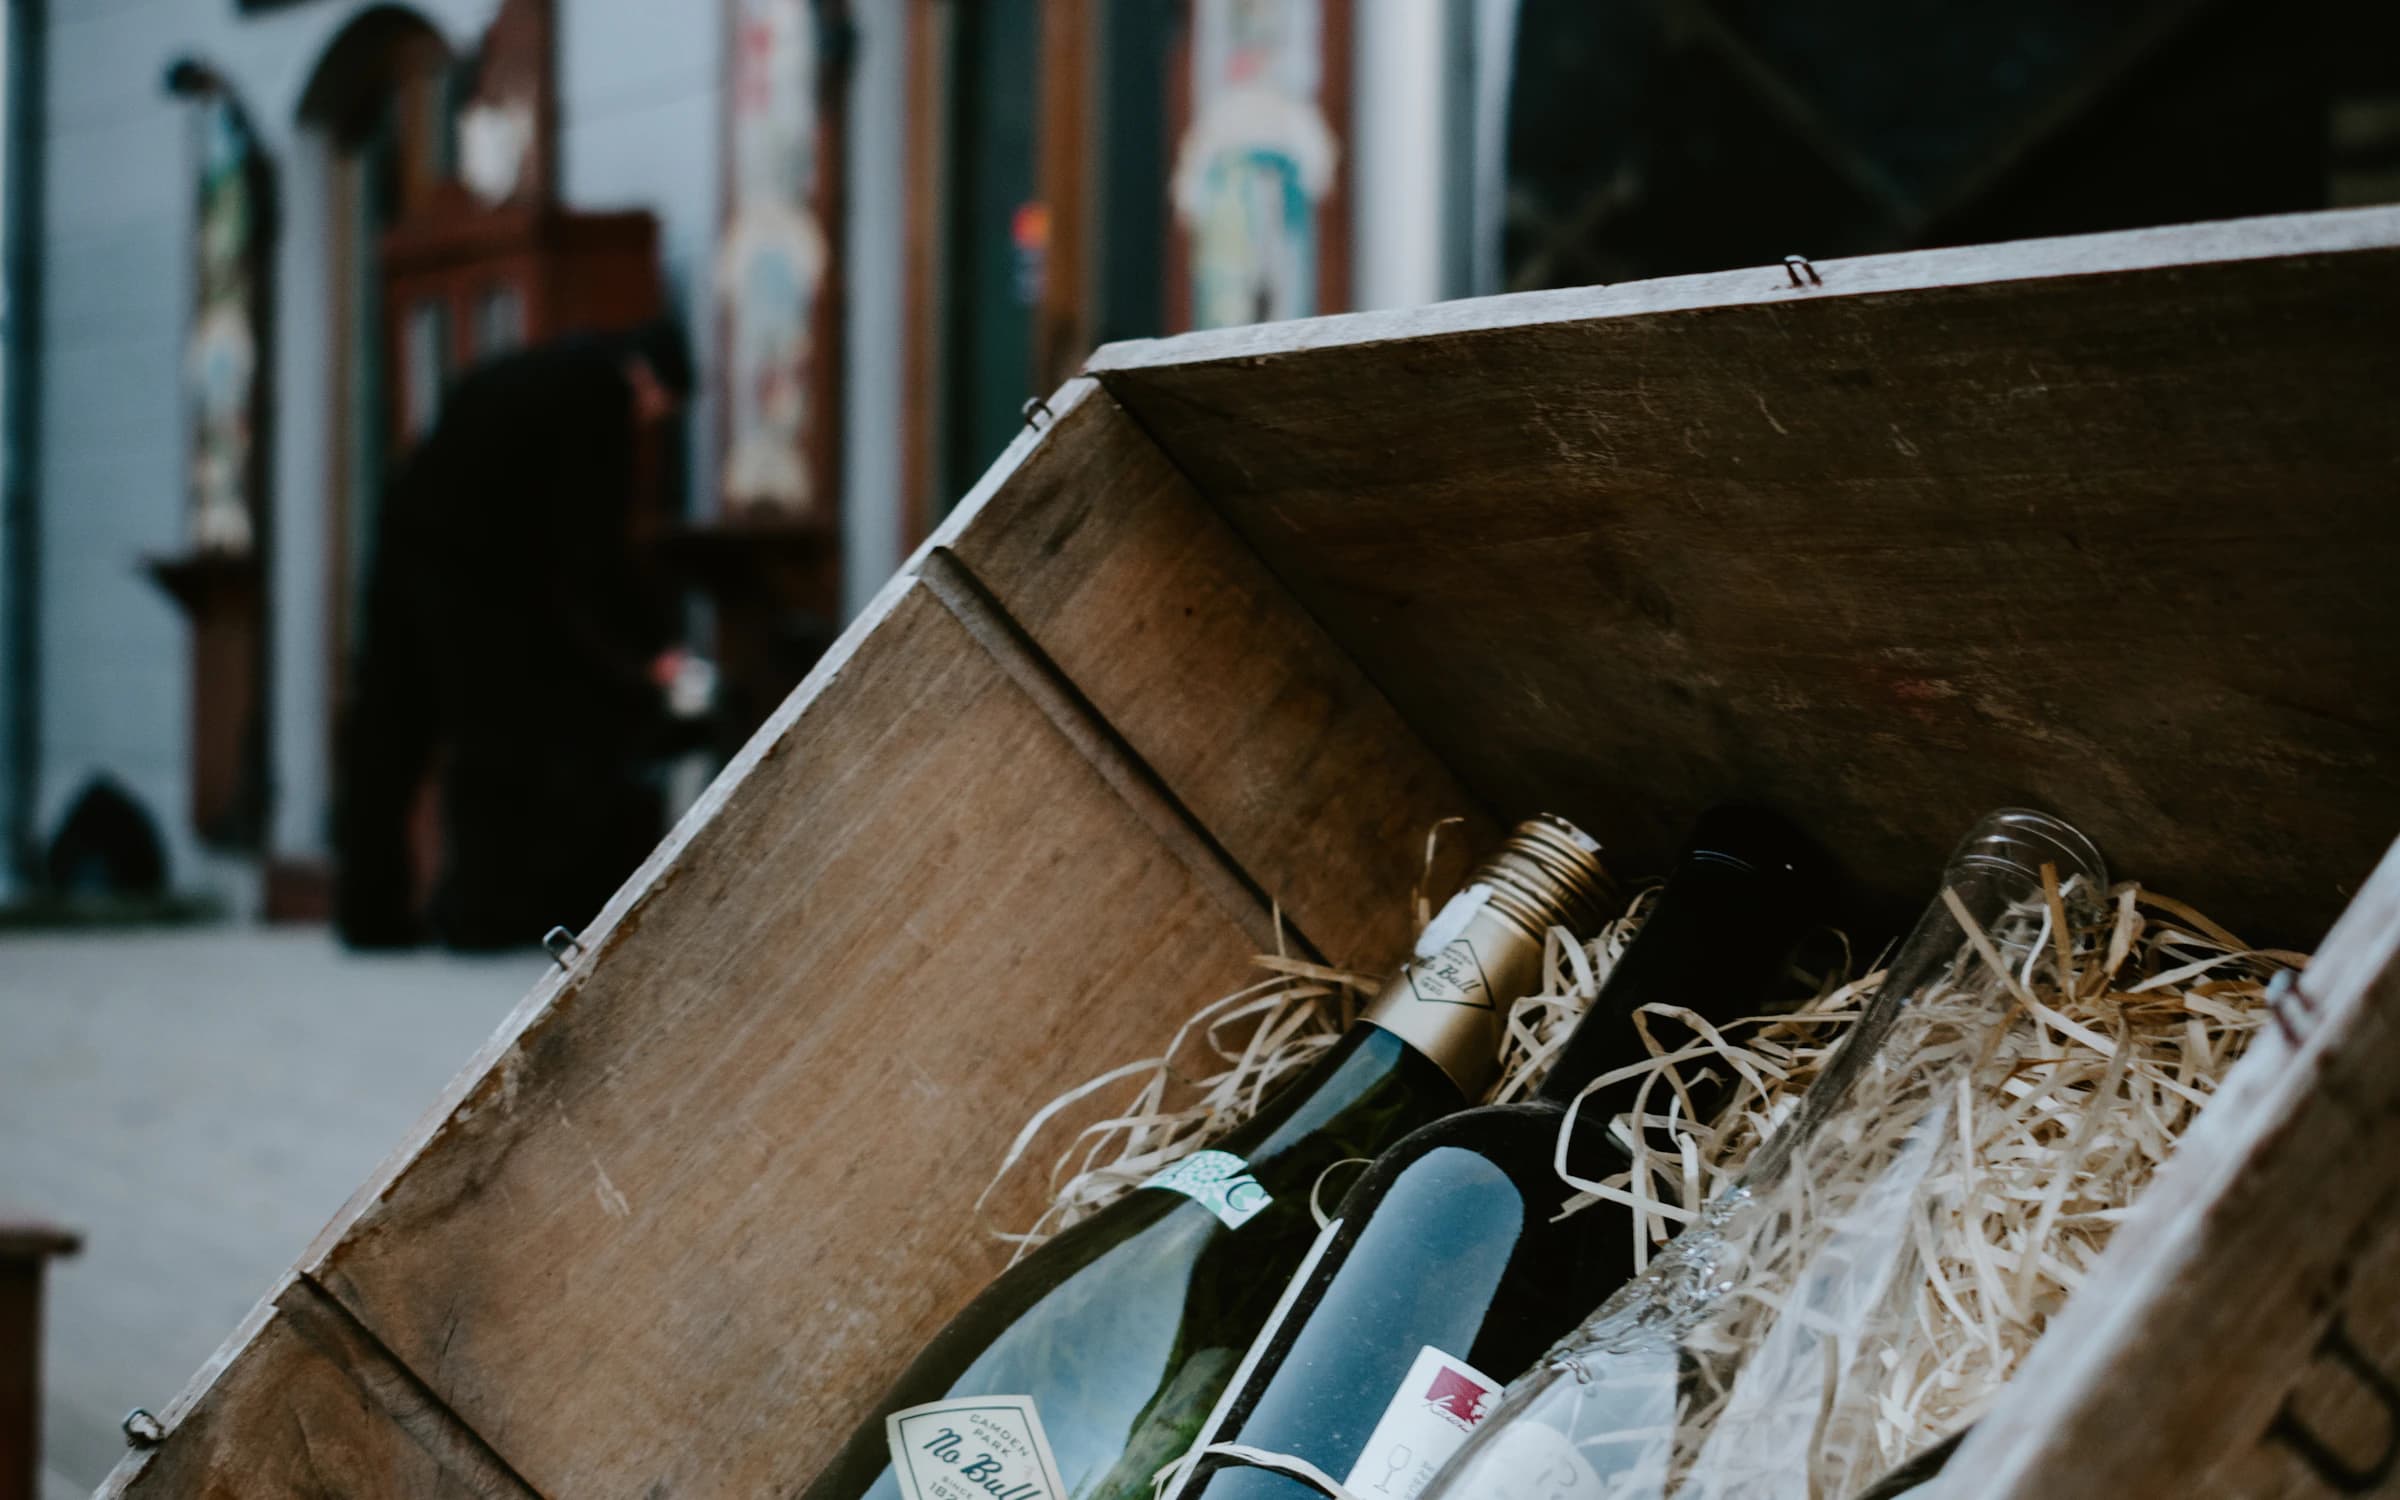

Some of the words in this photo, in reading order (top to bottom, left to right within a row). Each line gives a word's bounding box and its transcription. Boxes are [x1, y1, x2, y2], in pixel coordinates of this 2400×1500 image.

[970, 1413, 1030, 1457] CAMDEN
[973, 1428, 1012, 1458] PARK
[923, 1427, 963, 1464] No
[960, 1452, 1042, 1500] Bull
